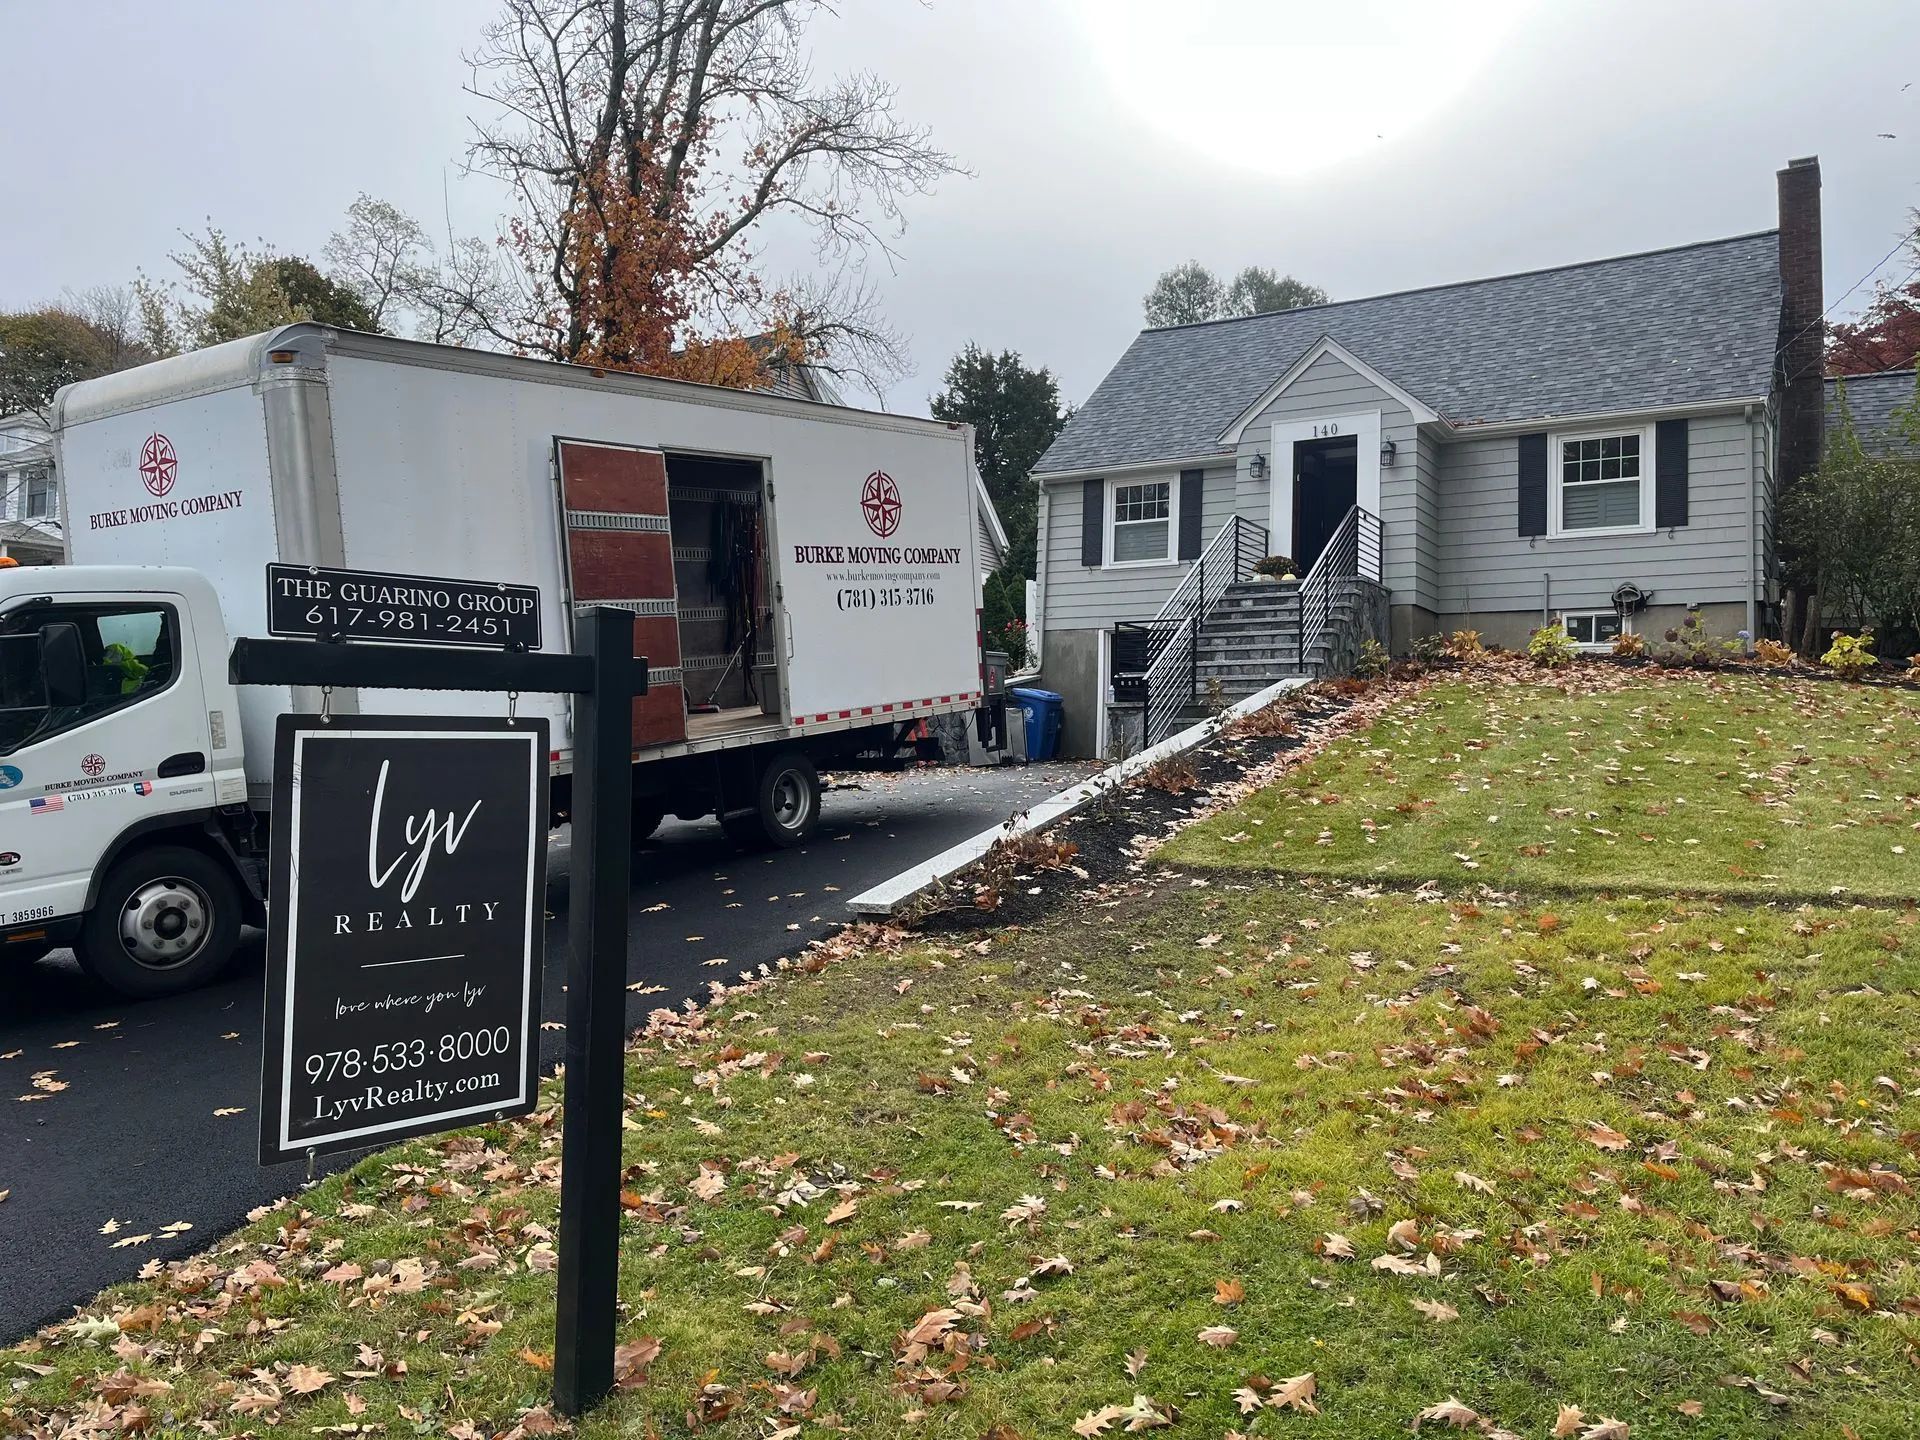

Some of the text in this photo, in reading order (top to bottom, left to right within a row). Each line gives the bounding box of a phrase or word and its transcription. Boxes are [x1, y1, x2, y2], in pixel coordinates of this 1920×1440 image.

[1312, 423, 1338, 437] 140
[90, 490, 243, 530] BURKE MOVING COMPANY
[794, 545, 961, 564] BURKE MOVING COMPANY
[826, 569, 941, 584] www.burkemovingcompany.com
[276, 577, 534, 615] THE GUARINO GROUP
[837, 588, 876, 611] (781)
[305, 605, 512, 636] 617-981-2451
[44, 781, 72, 791] BURKE
[73, 776, 105, 787] MOVING
[106, 771, 144, 781] COMPANY
[67, 792, 91, 803] (781)
[368, 759, 482, 903] Lyv
[12, 905, 54, 922] 3859966
[334, 901, 500, 935] REALTY
[335, 981, 487, 1020] love where you lyv
[313, 1072, 501, 1121] LyvRealty.com
